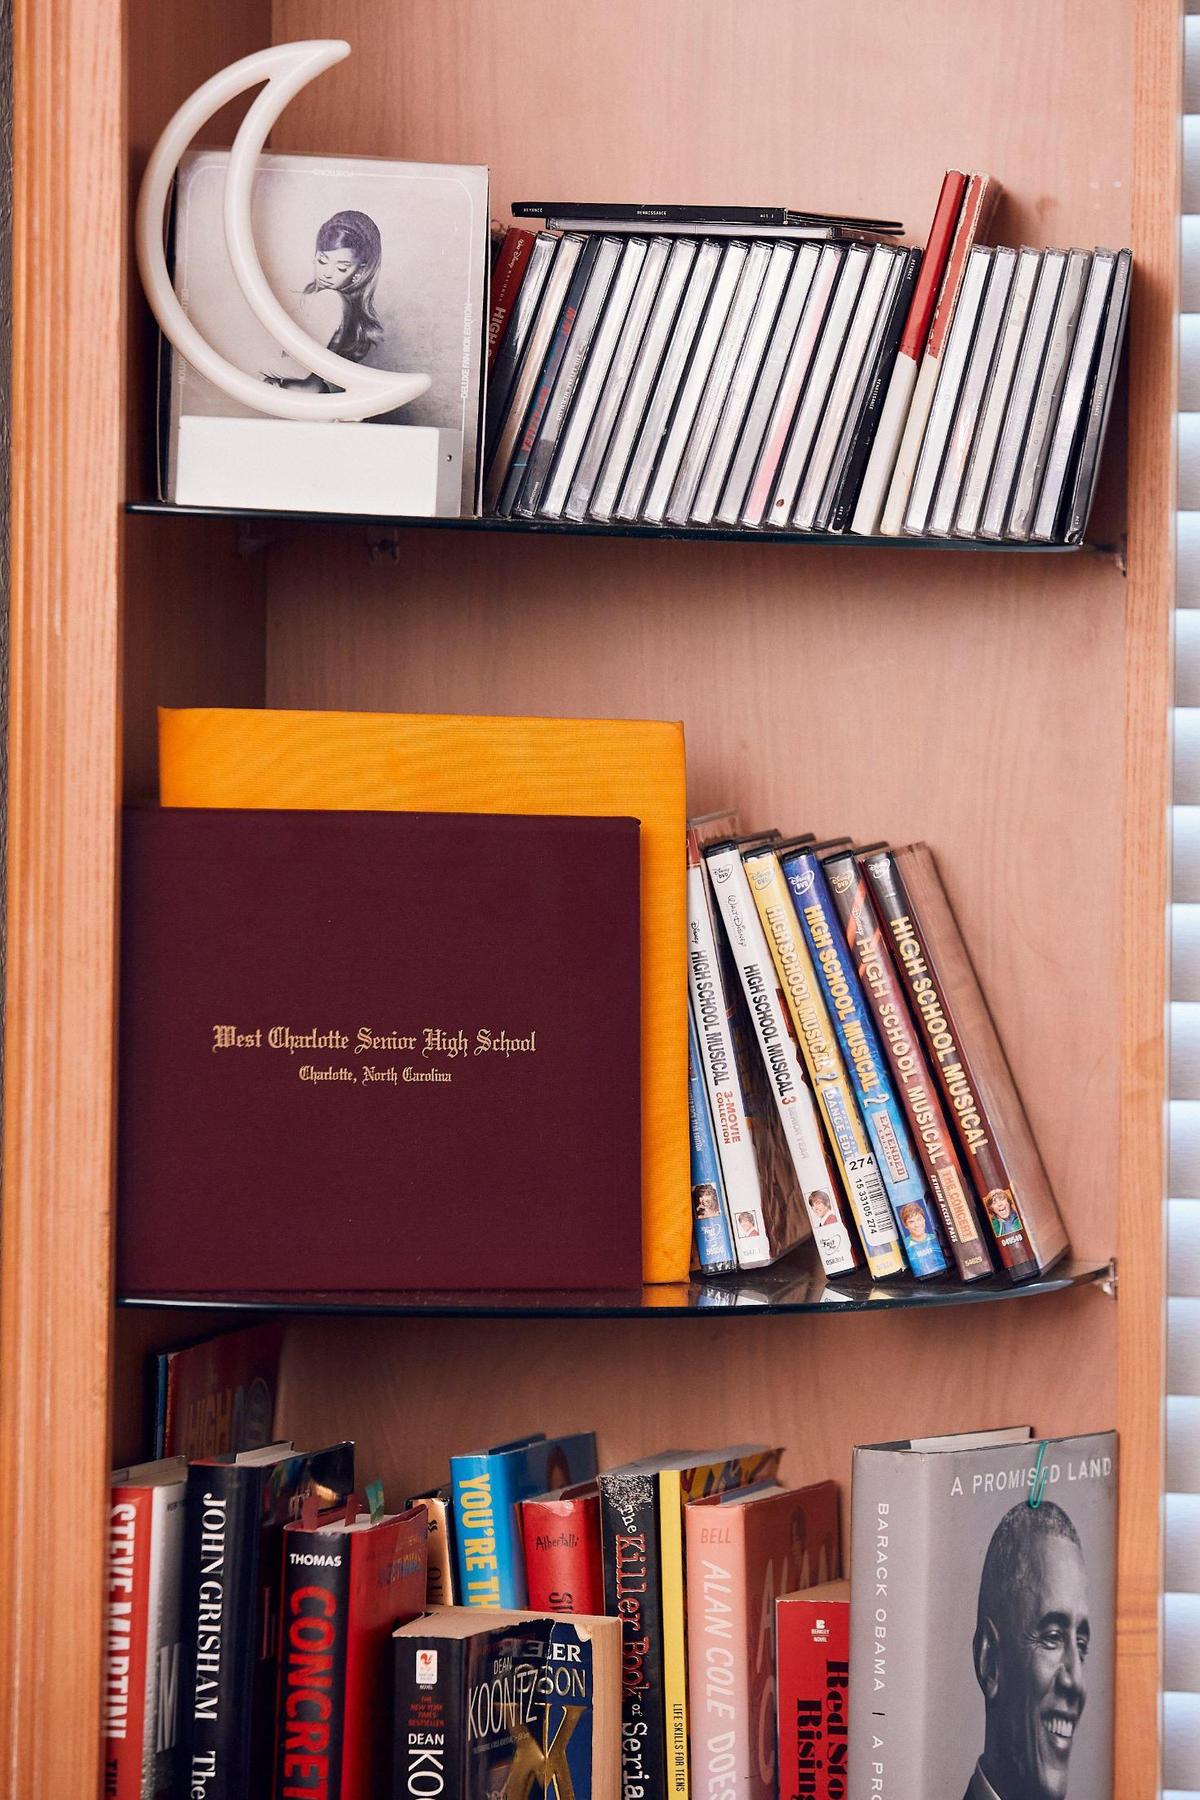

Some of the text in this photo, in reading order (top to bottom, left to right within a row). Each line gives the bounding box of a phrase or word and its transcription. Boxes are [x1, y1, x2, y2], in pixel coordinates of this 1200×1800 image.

[460, 303, 473, 399] DELUXE FAN BOX EDITION
[765, 904, 793, 945] HIGH
[804, 904, 834, 948] HIGH
[778, 944, 810, 1007] SCHOOL
[818, 948, 856, 1021] SCHOOL
[212, 1024, 537, 1059] West Charlotte Senior High School
[690, 949, 730, 1087] HIGH SCHOOL MUSICAL
[743, 963, 797, 1105] HIGH SCHOOL MUSICAL 3
[798, 1006, 831, 1072] MUSICAL
[890, 916, 989, 1155] HIGH SCHOOL MUSICAL
[299, 1065, 452, 1086] Charlotte, North Carolina
[842, 1020, 880, 1093] MUSICAL
[856, 939, 947, 1165] HIGH SCHOOL MUSICAL
[715, 1091, 731, 1145] COLLECTION
[723, 1090, 742, 1144] 3-MOVIE
[823, 1087, 845, 1133] DANCE
[848, 1157, 874, 1171] 274
[878, 1114, 906, 1177] EXTENDED
[855, 1178, 877, 1235] 15 33105 274
[929, 1173, 958, 1243] EXTREME ACCESS PASS
[942, 1169, 974, 1237] THE CONCERT
[950, 1476, 964, 1497] A
[1068, 1457, 1112, 1481] LAND
[110, 1503, 137, 1593] STEVE
[459, 1473, 497, 1571] YOU'RE
[535, 1533, 579, 1551] Albertalli
[619, 1504, 637, 1534] The
[700, 1527, 732, 1544] BELL
[875, 1503, 890, 1597] BARACK
[289, 1553, 342, 1568] THOMAS
[615, 1533, 648, 1631] Killer
[701, 1559, 734, 1640] ALAN
[107, 1602, 132, 1739] MARTINI
[190, 1492, 227, 1799] JOHN GRISHAM The
[493, 1656, 513, 1676] DEAN
[622, 1636, 651, 1702] Book
[873, 1608, 887, 1692] OBAMA
[467, 1669, 539, 1742] KOONTZ
[631, 1703, 643, 1717] of
[705, 1646, 736, 1720] COLE
[826, 1660, 849, 1736] Red
[408, 1732, 444, 1746] DEAN
[672, 1703, 686, 1792] LIFE SKILLS FOR TEENS
[871, 1735, 884, 1749] A
[407, 1749, 445, 1800] KO
